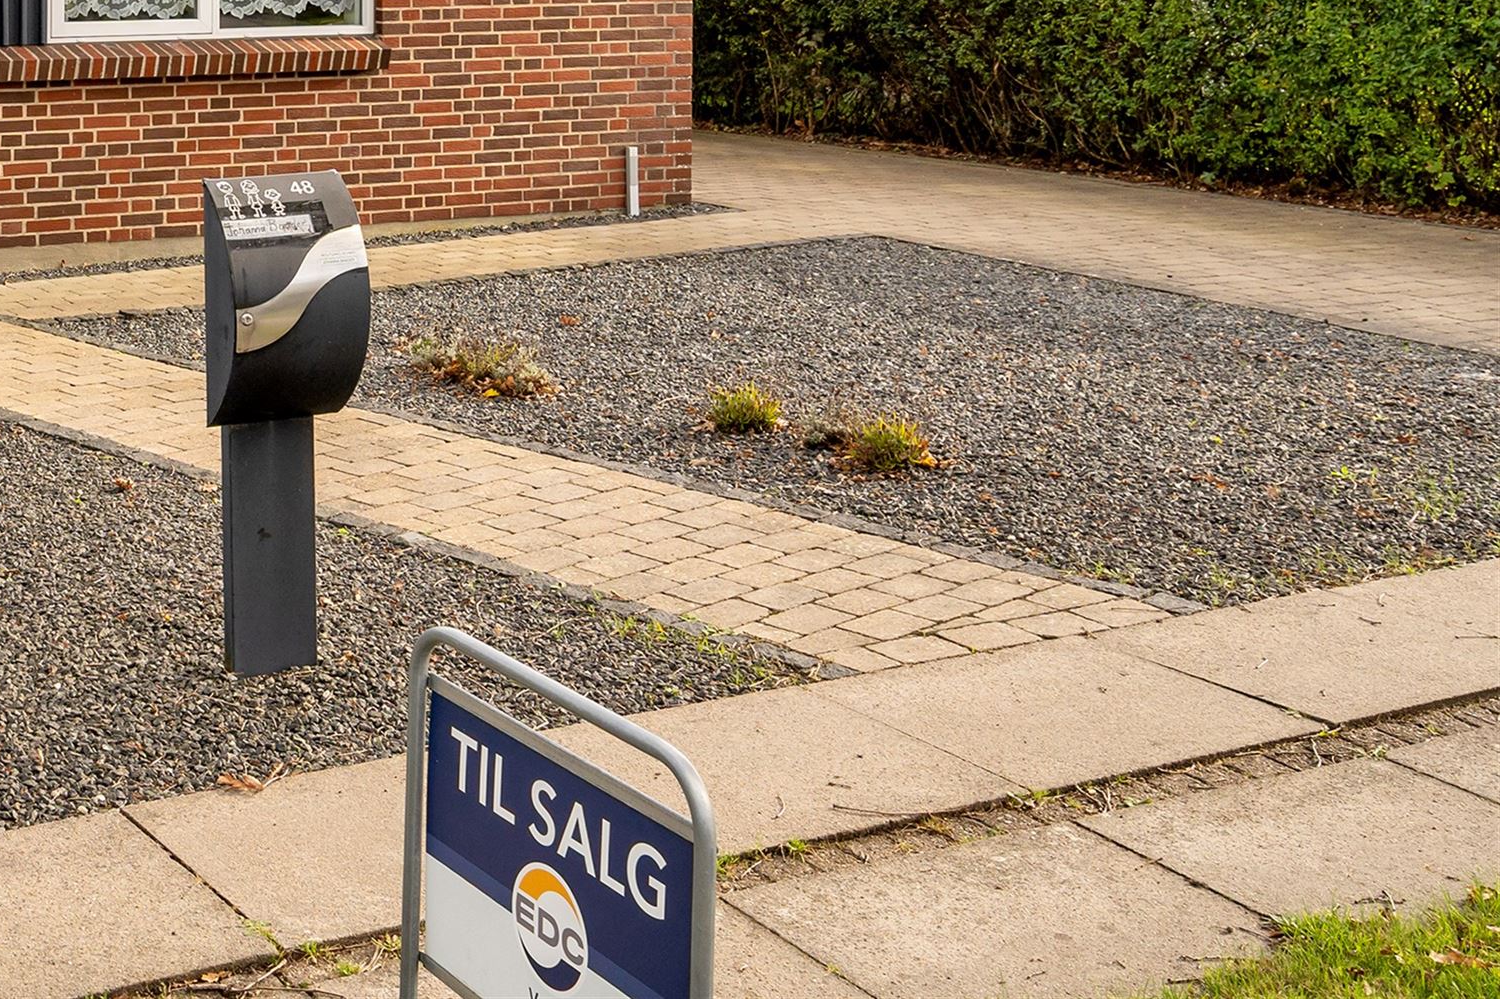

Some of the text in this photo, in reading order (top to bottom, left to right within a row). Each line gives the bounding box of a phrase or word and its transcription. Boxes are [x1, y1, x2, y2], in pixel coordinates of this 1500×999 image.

[290, 180, 315, 194] 48
[451, 726, 666, 920] TIL SALG
[515, 891, 584, 967] EDC
